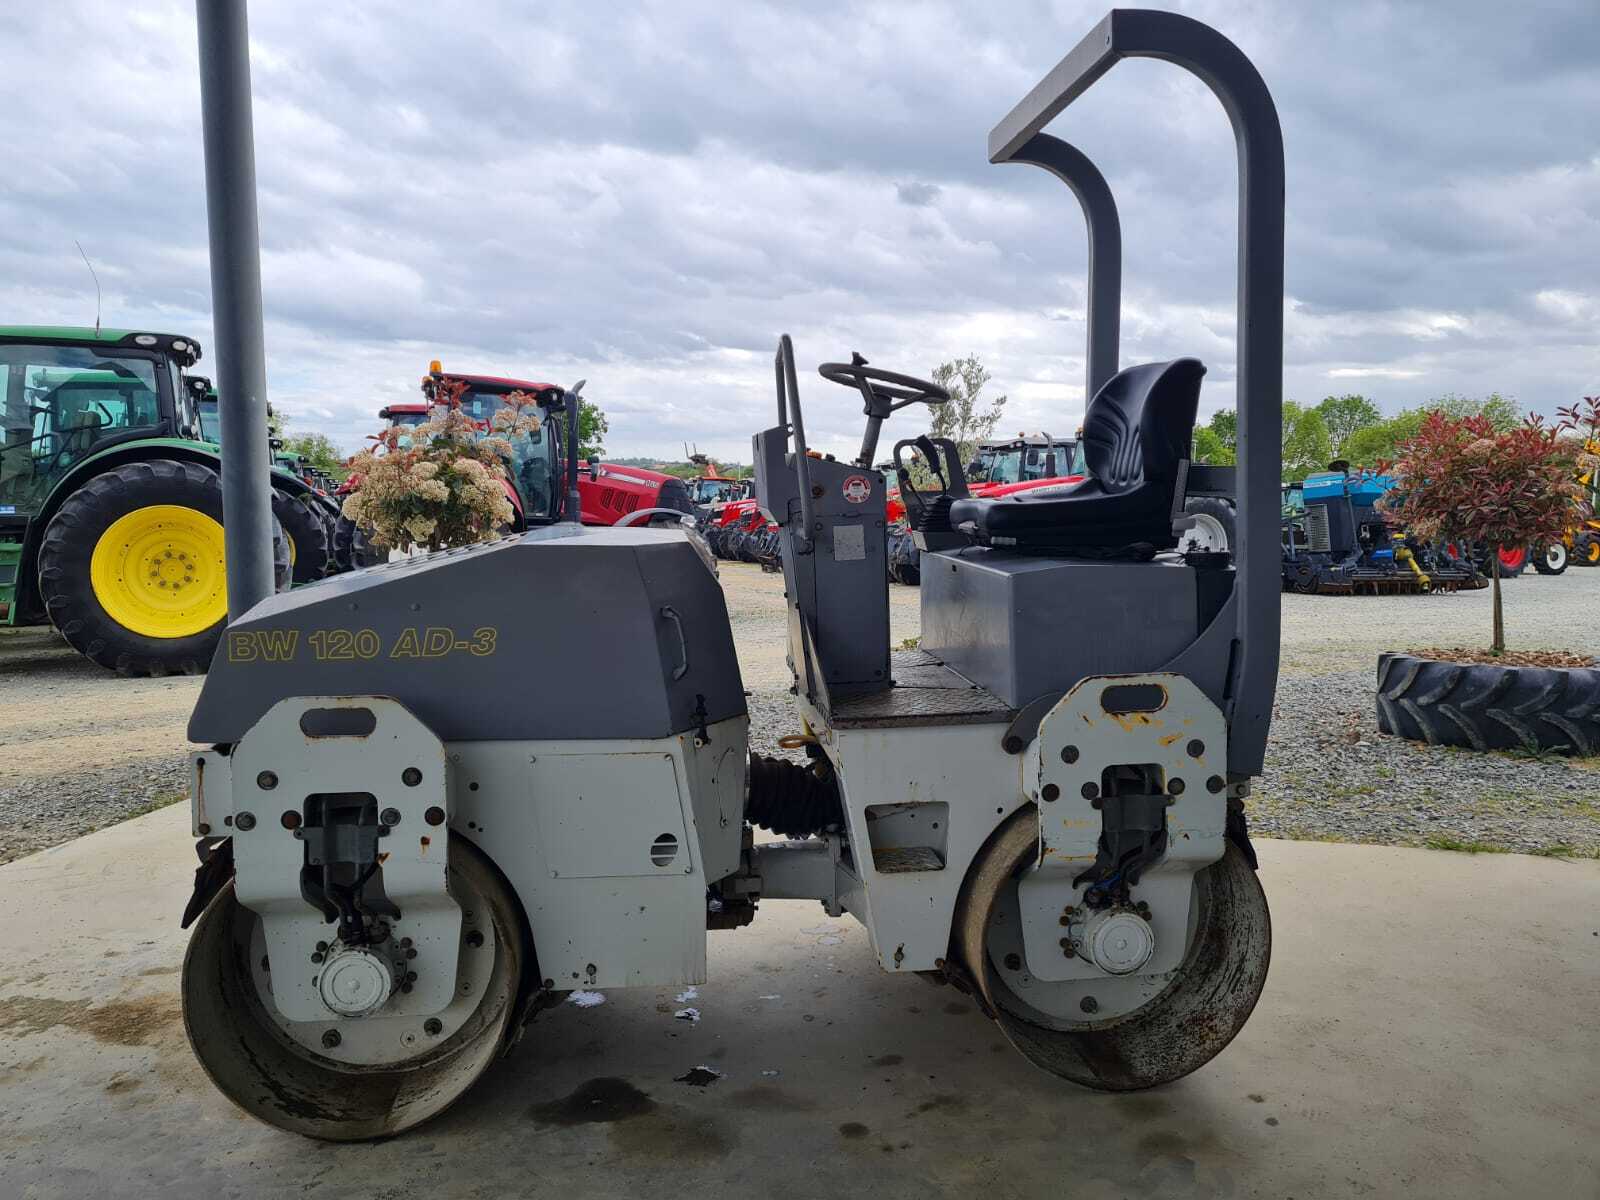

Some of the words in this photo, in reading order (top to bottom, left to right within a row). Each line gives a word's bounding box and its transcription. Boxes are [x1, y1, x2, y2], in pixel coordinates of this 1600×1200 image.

[228, 631, 299, 662] BW
[308, 629, 381, 659] 120
[390, 628, 497, 657] AD-3
